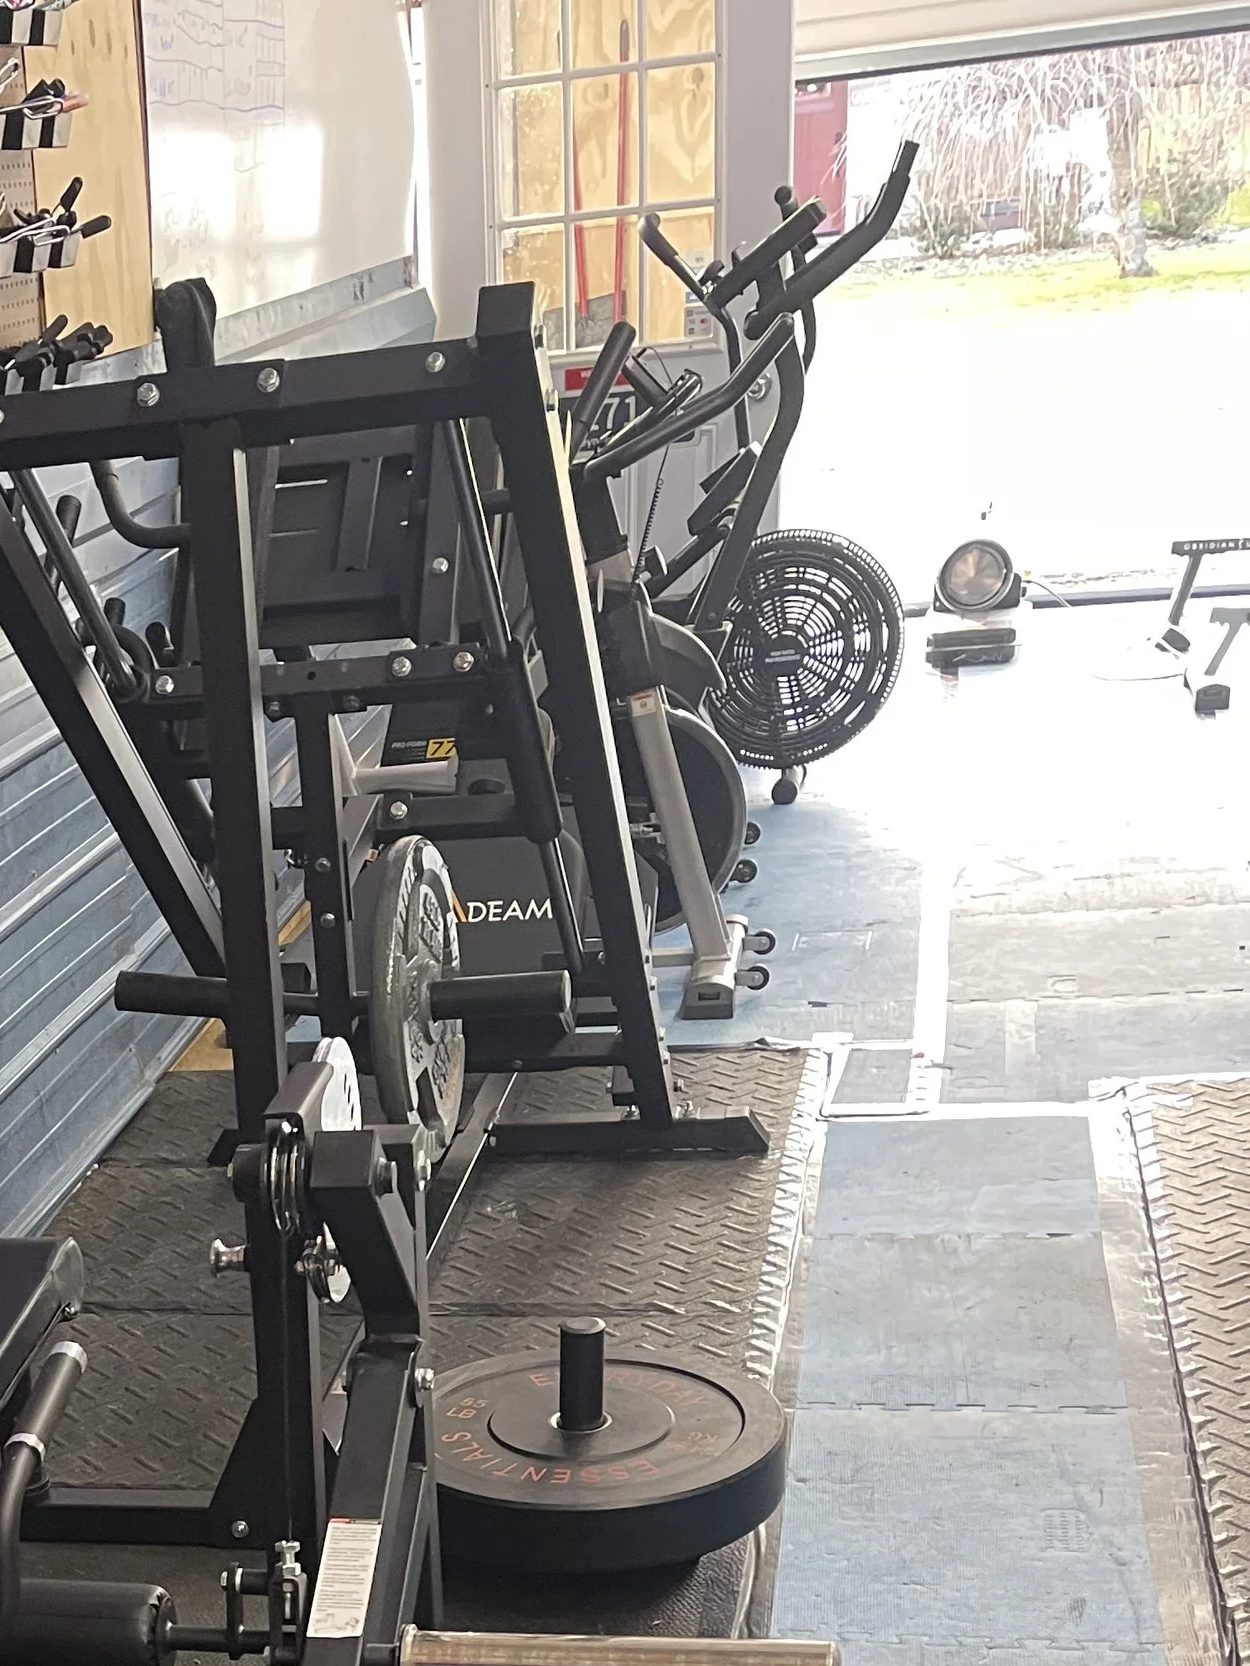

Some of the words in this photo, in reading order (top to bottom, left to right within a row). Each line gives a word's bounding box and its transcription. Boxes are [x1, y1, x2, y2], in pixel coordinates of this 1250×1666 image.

[590, 395, 636, 431] 71
[528, 1371, 710, 1405] ERYDAY
[446, 1408, 478, 1420] LB
[442, 1431, 659, 1484] ESSENTIALS
